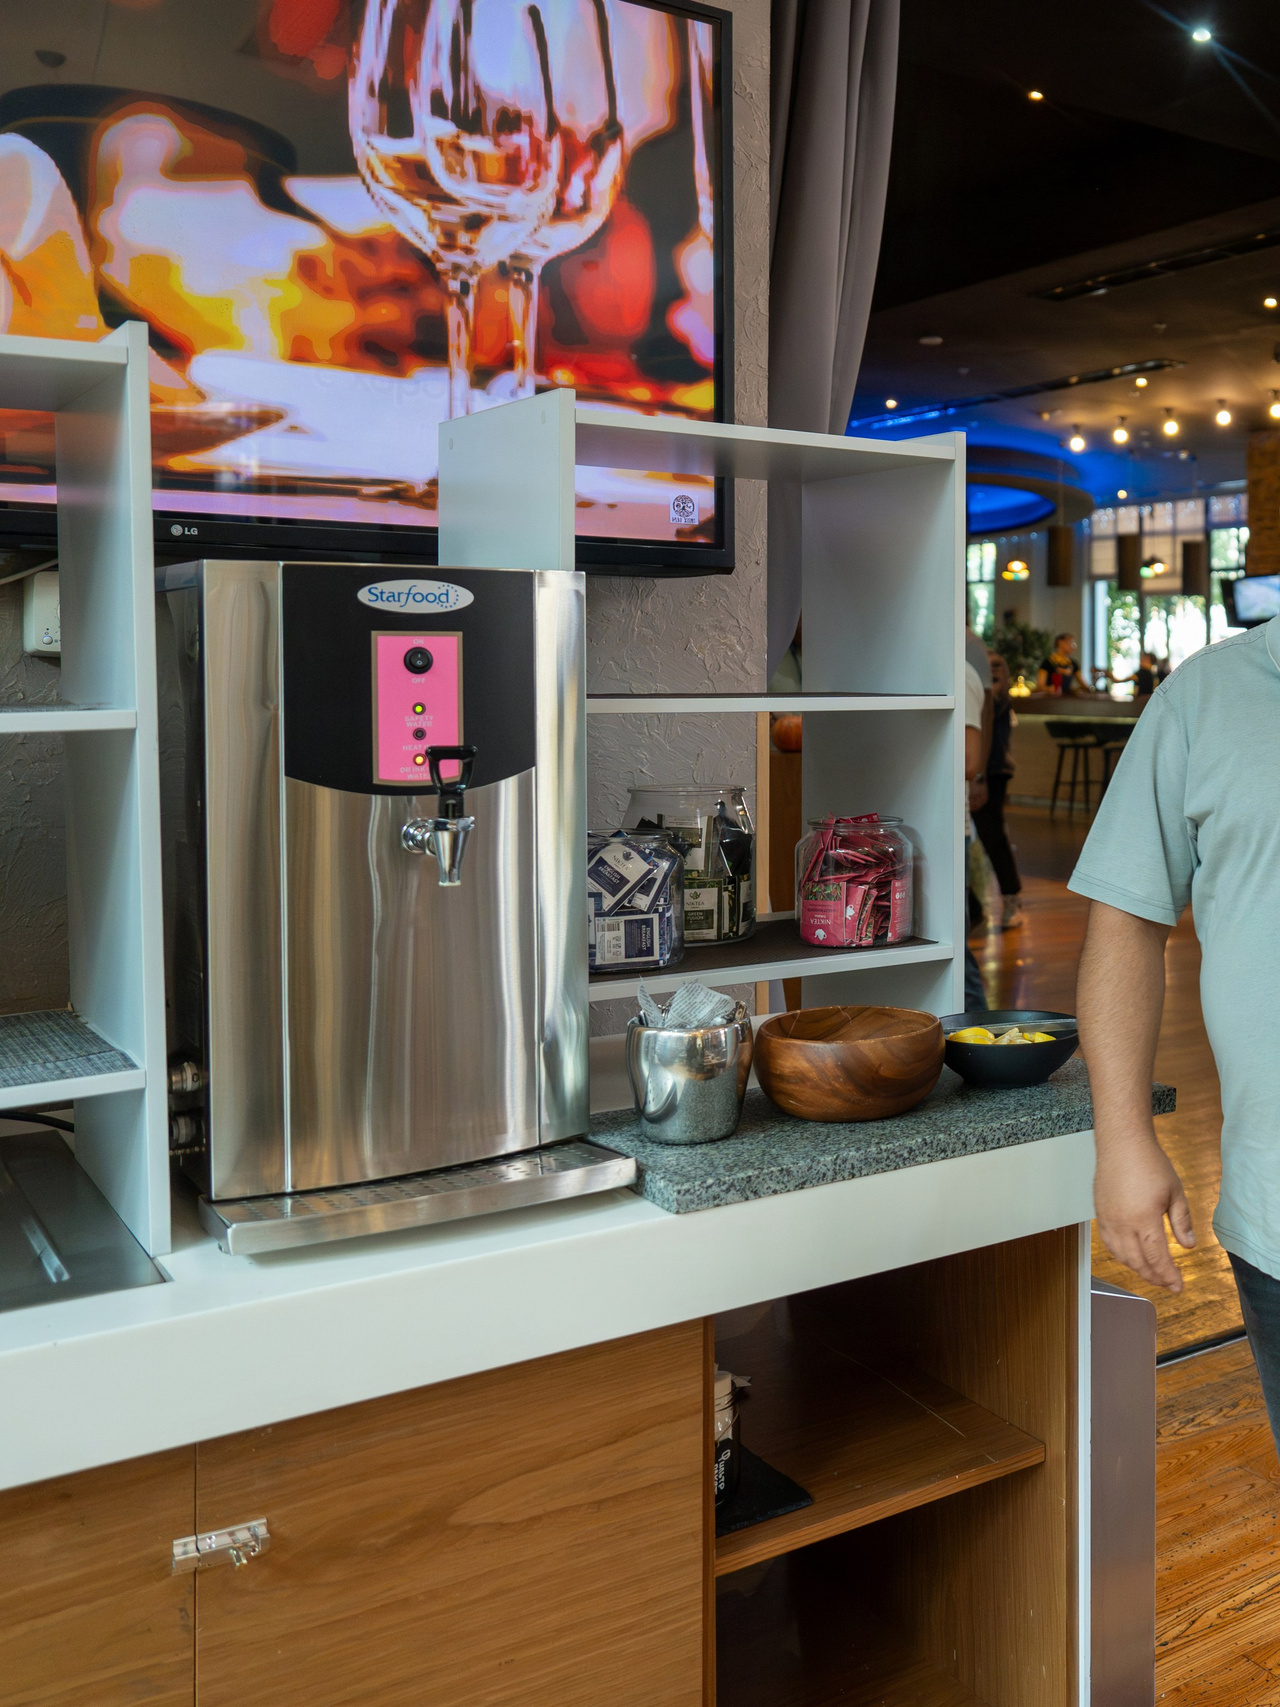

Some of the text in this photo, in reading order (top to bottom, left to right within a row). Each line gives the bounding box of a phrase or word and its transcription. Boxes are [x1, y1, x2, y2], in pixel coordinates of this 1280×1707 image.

[184, 527, 199, 535] LG
[367, 584, 450, 608] Starfood
[597, 866, 621, 885] BREAKFAST
[603, 864, 621, 880] ENGLISH
